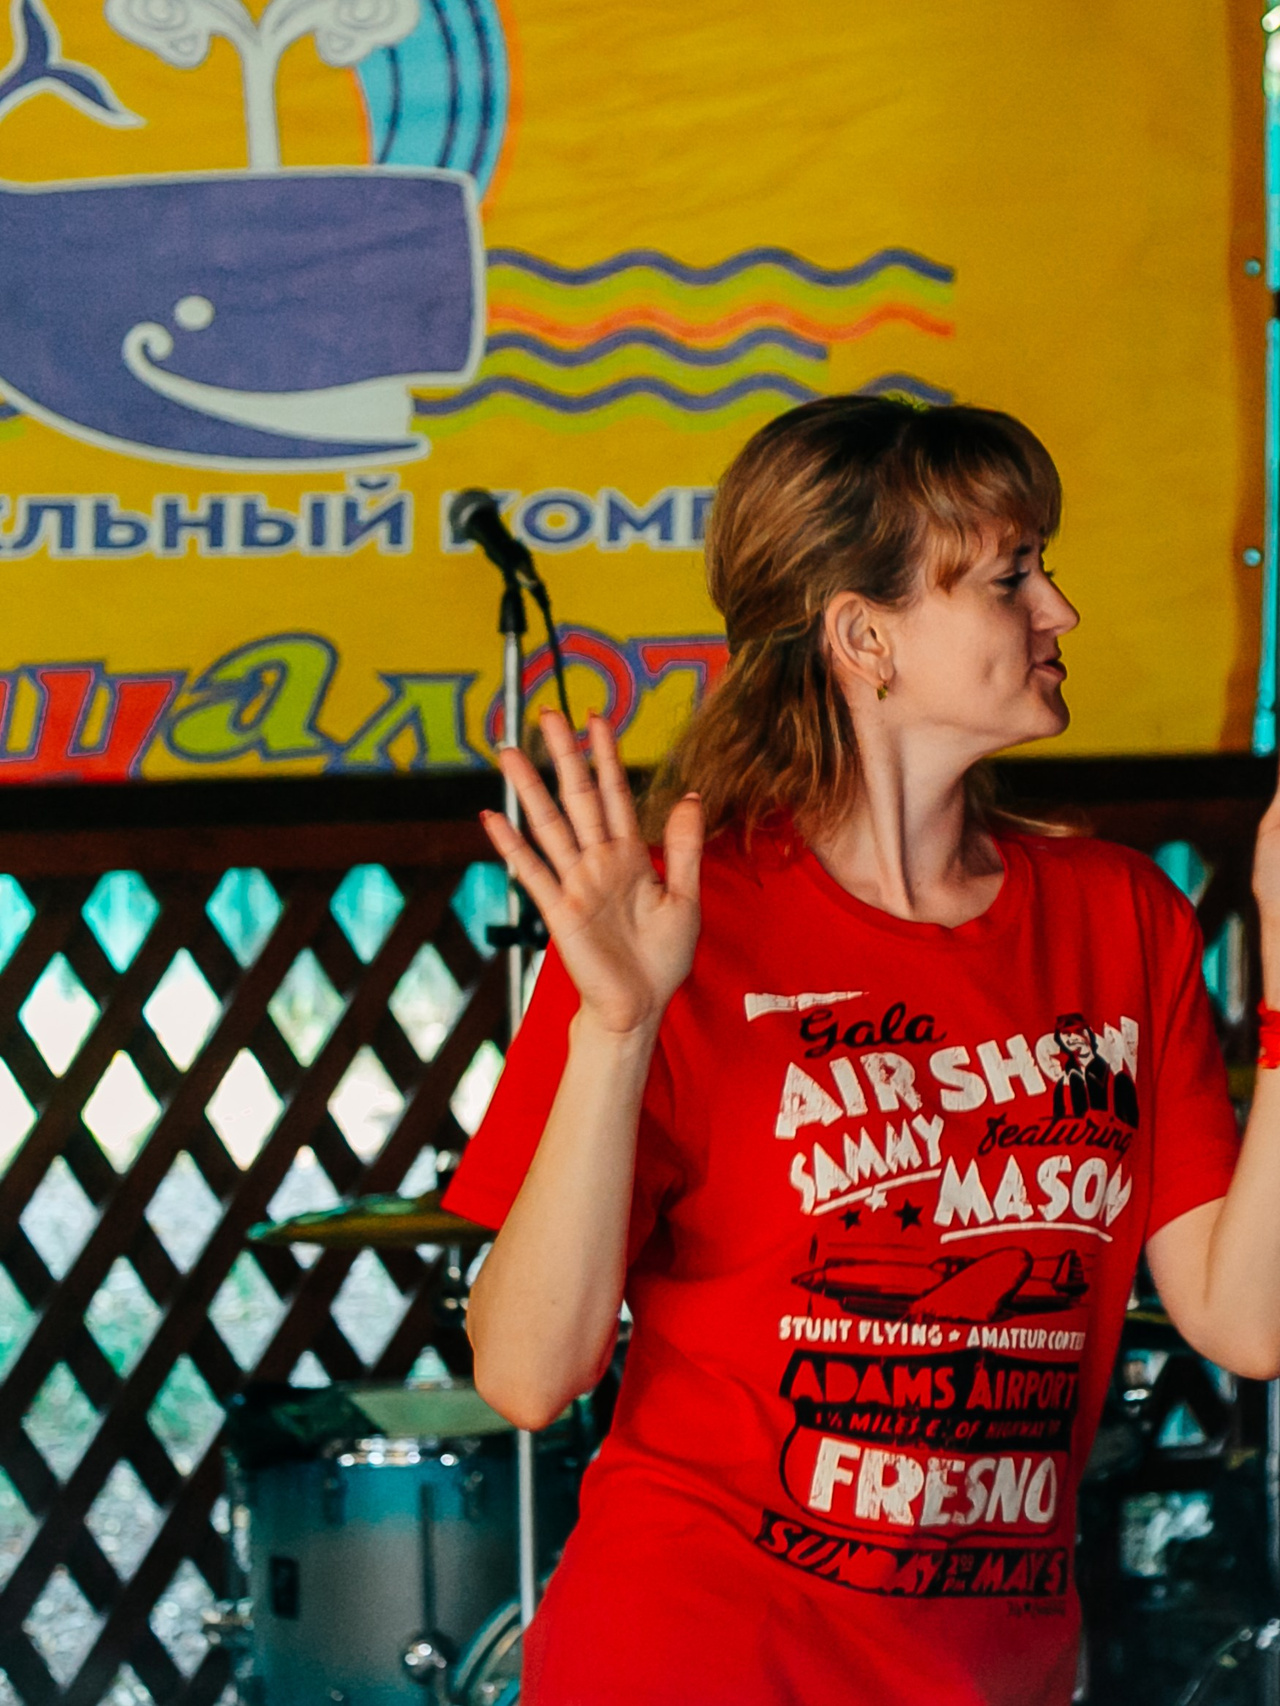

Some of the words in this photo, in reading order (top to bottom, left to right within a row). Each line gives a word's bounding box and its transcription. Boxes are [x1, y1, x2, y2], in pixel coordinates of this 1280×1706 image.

[0, 475, 413, 558] ЛЬНЫЙ
[800, 1002, 947, 1058] Gala
[789, 1114, 945, 1215] SAMMY
[978, 1112, 1134, 1162] featuring
[934, 1154, 1132, 1228] MASON
[779, 1315, 852, 1343] STUNT
[858, 1322, 944, 1348] FLYING
[967, 1326, 1047, 1350] AMATEUR
[789, 1360, 956, 1410] ADAMS
[966, 1363, 1079, 1411] AIRPORT
[849, 1410, 921, 1436] MILES
[955, 1420, 982, 1440] OF
[808, 1437, 1057, 1527] FRESNO
[758, 1520, 943, 1595] SUNDAY
